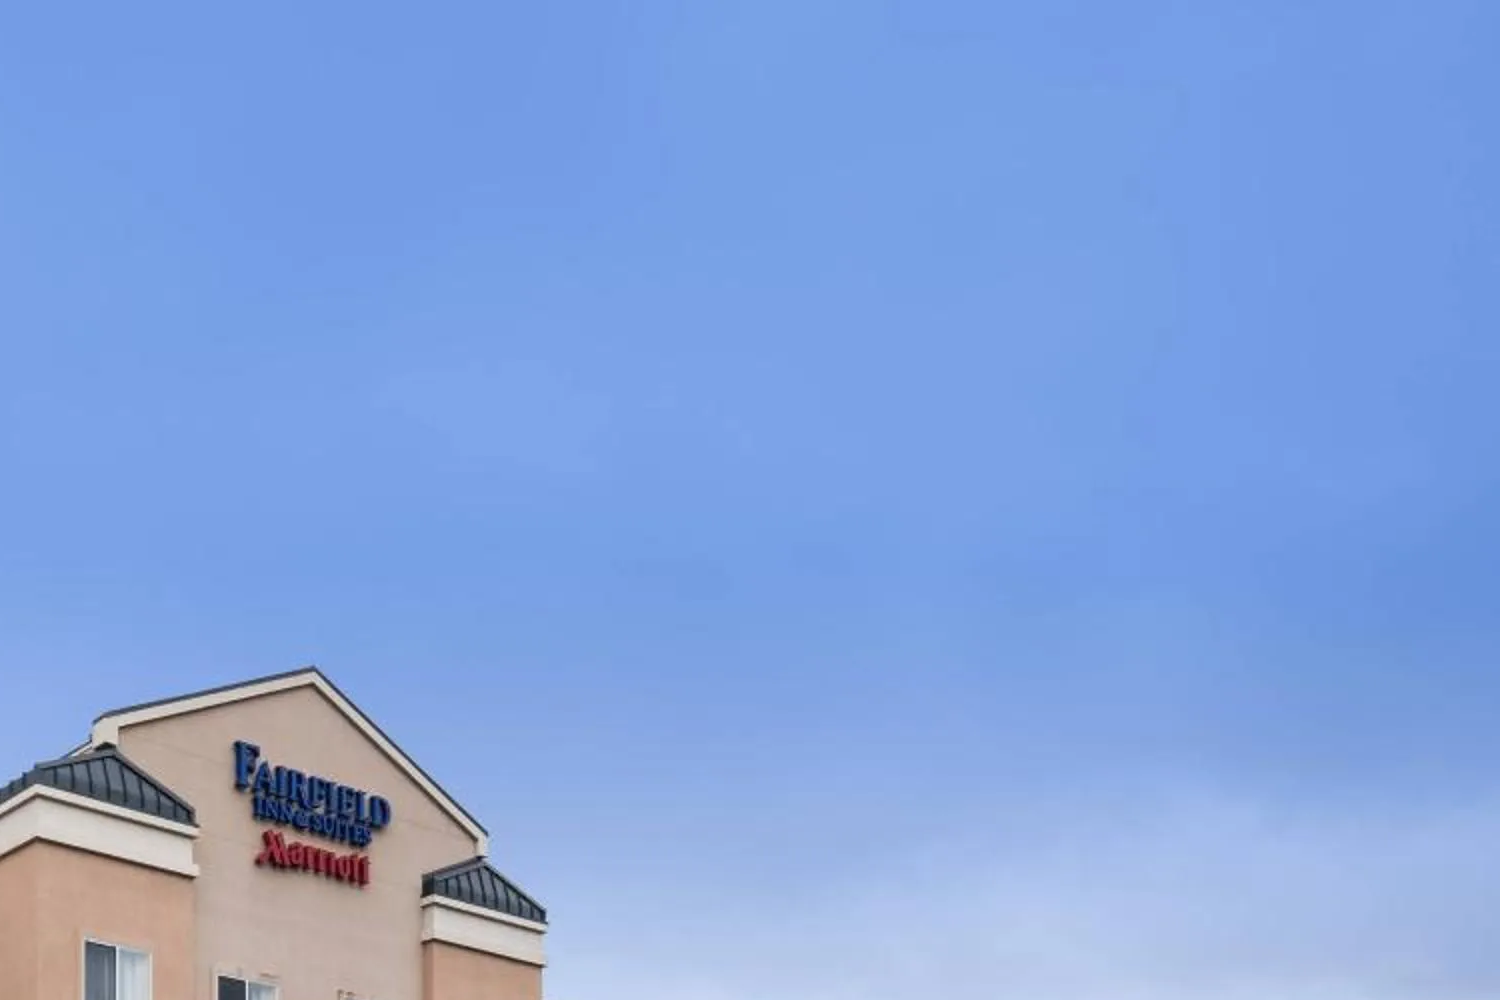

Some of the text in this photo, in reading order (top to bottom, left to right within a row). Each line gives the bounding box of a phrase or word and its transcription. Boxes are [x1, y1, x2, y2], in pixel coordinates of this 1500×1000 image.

[233, 740, 391, 830] FAIRFIELD
[253, 797, 294, 826] INN
[308, 812, 372, 847] SUITES
[255, 829, 371, 886] Marriott
